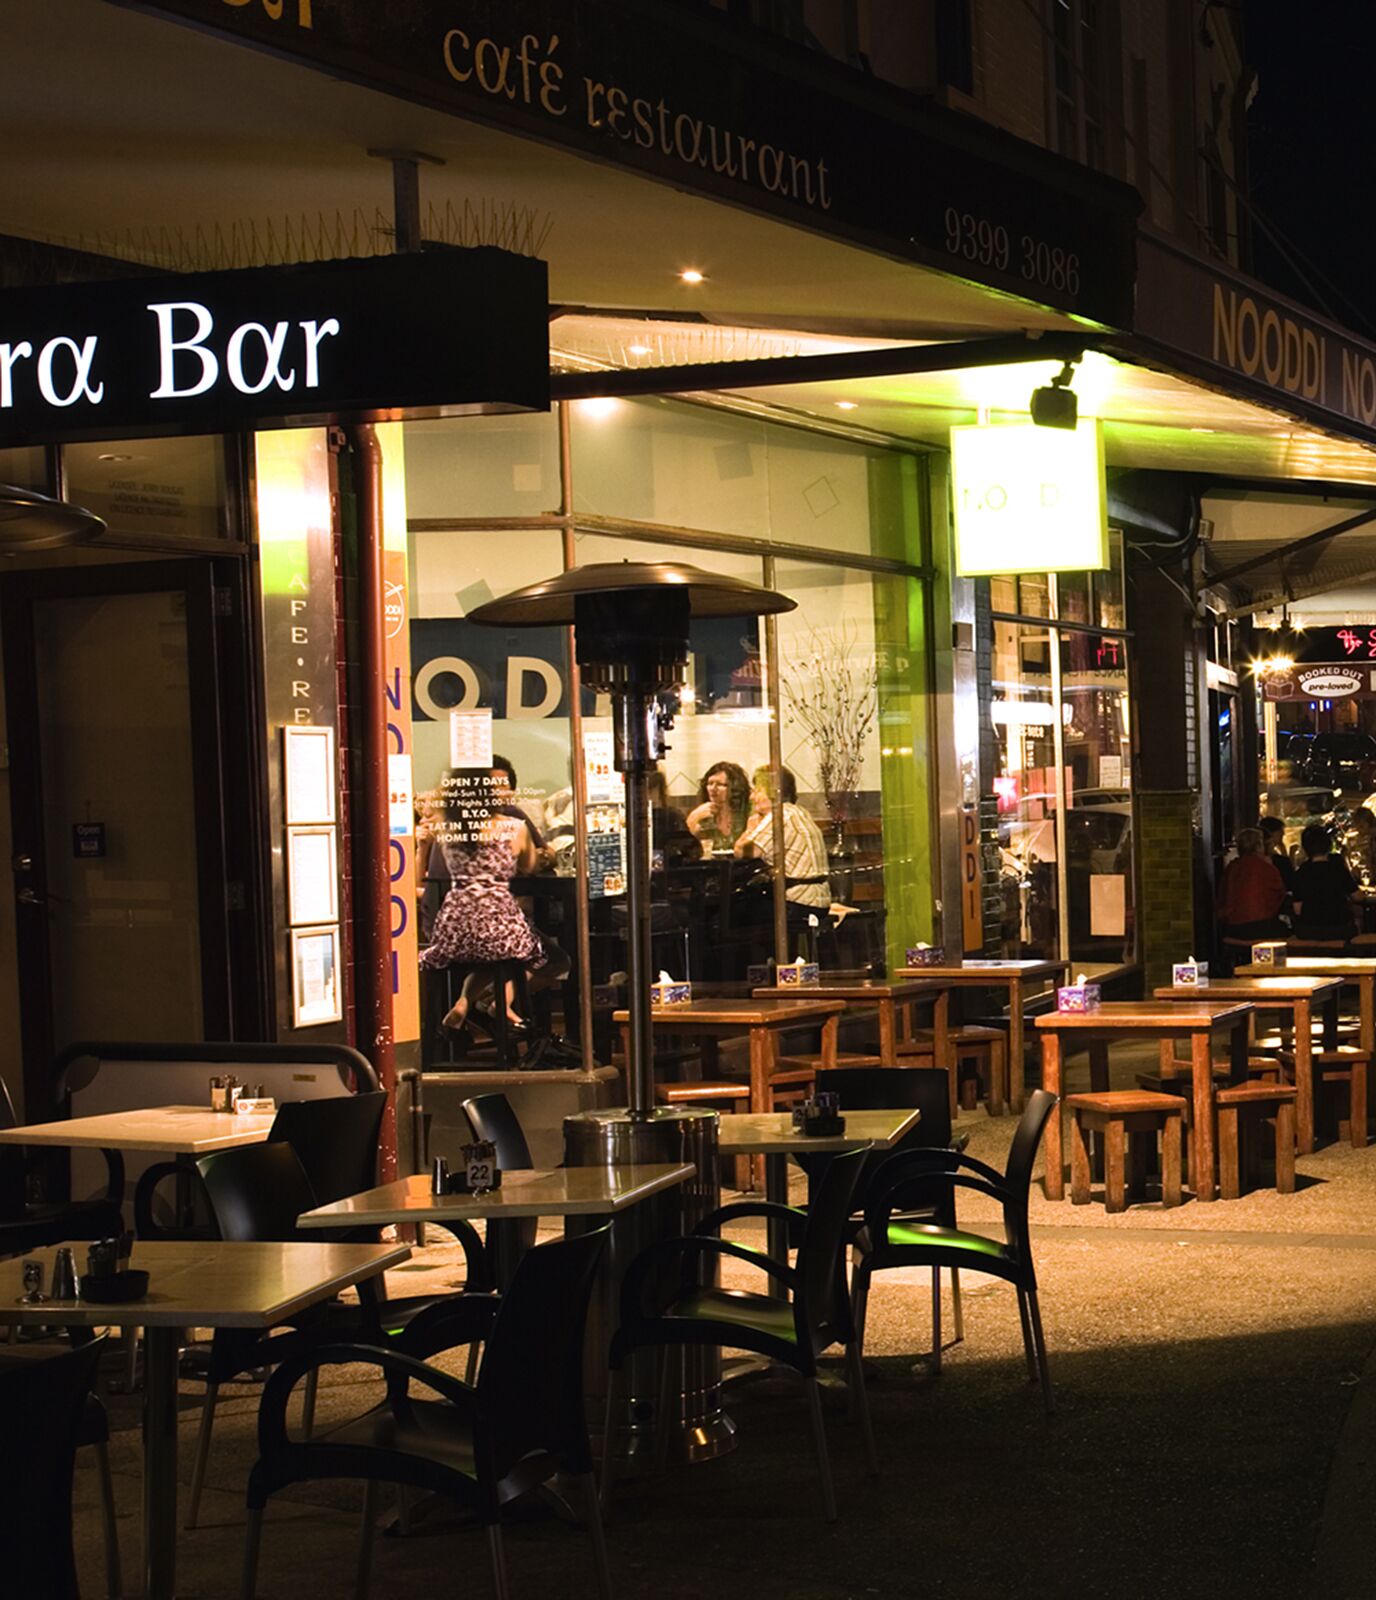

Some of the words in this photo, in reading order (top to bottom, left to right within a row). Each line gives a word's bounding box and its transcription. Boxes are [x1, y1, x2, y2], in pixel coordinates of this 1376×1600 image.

[443, 29, 567, 116] café
[583, 75, 832, 210] restaurant
[944, 207, 1010, 272] 9399
[1021, 235, 1080, 297] 3086
[1212, 283, 1326, 405] NOODDI
[146, 302, 340, 399] Bar
[1297, 666, 1341, 684] BOOKED
[1342, 667, 1365, 681] OUT
[1308, 682, 1355, 692] pre-loved
[441, 777, 471, 787] OPEN
[474, 777, 480, 786] 7
[482, 776, 509, 786] DAYS
[441, 789, 476, 799] Wed-Sun
[449, 800, 455, 808] 7
[457, 799, 483, 809] Nights
[461, 809, 492, 819] B.Y.O.
[449, 822, 462, 831] IN
[468, 821, 493, 830] TAKE
[436, 833, 468, 842] HOME
[470, 1164, 489, 1182] 22
